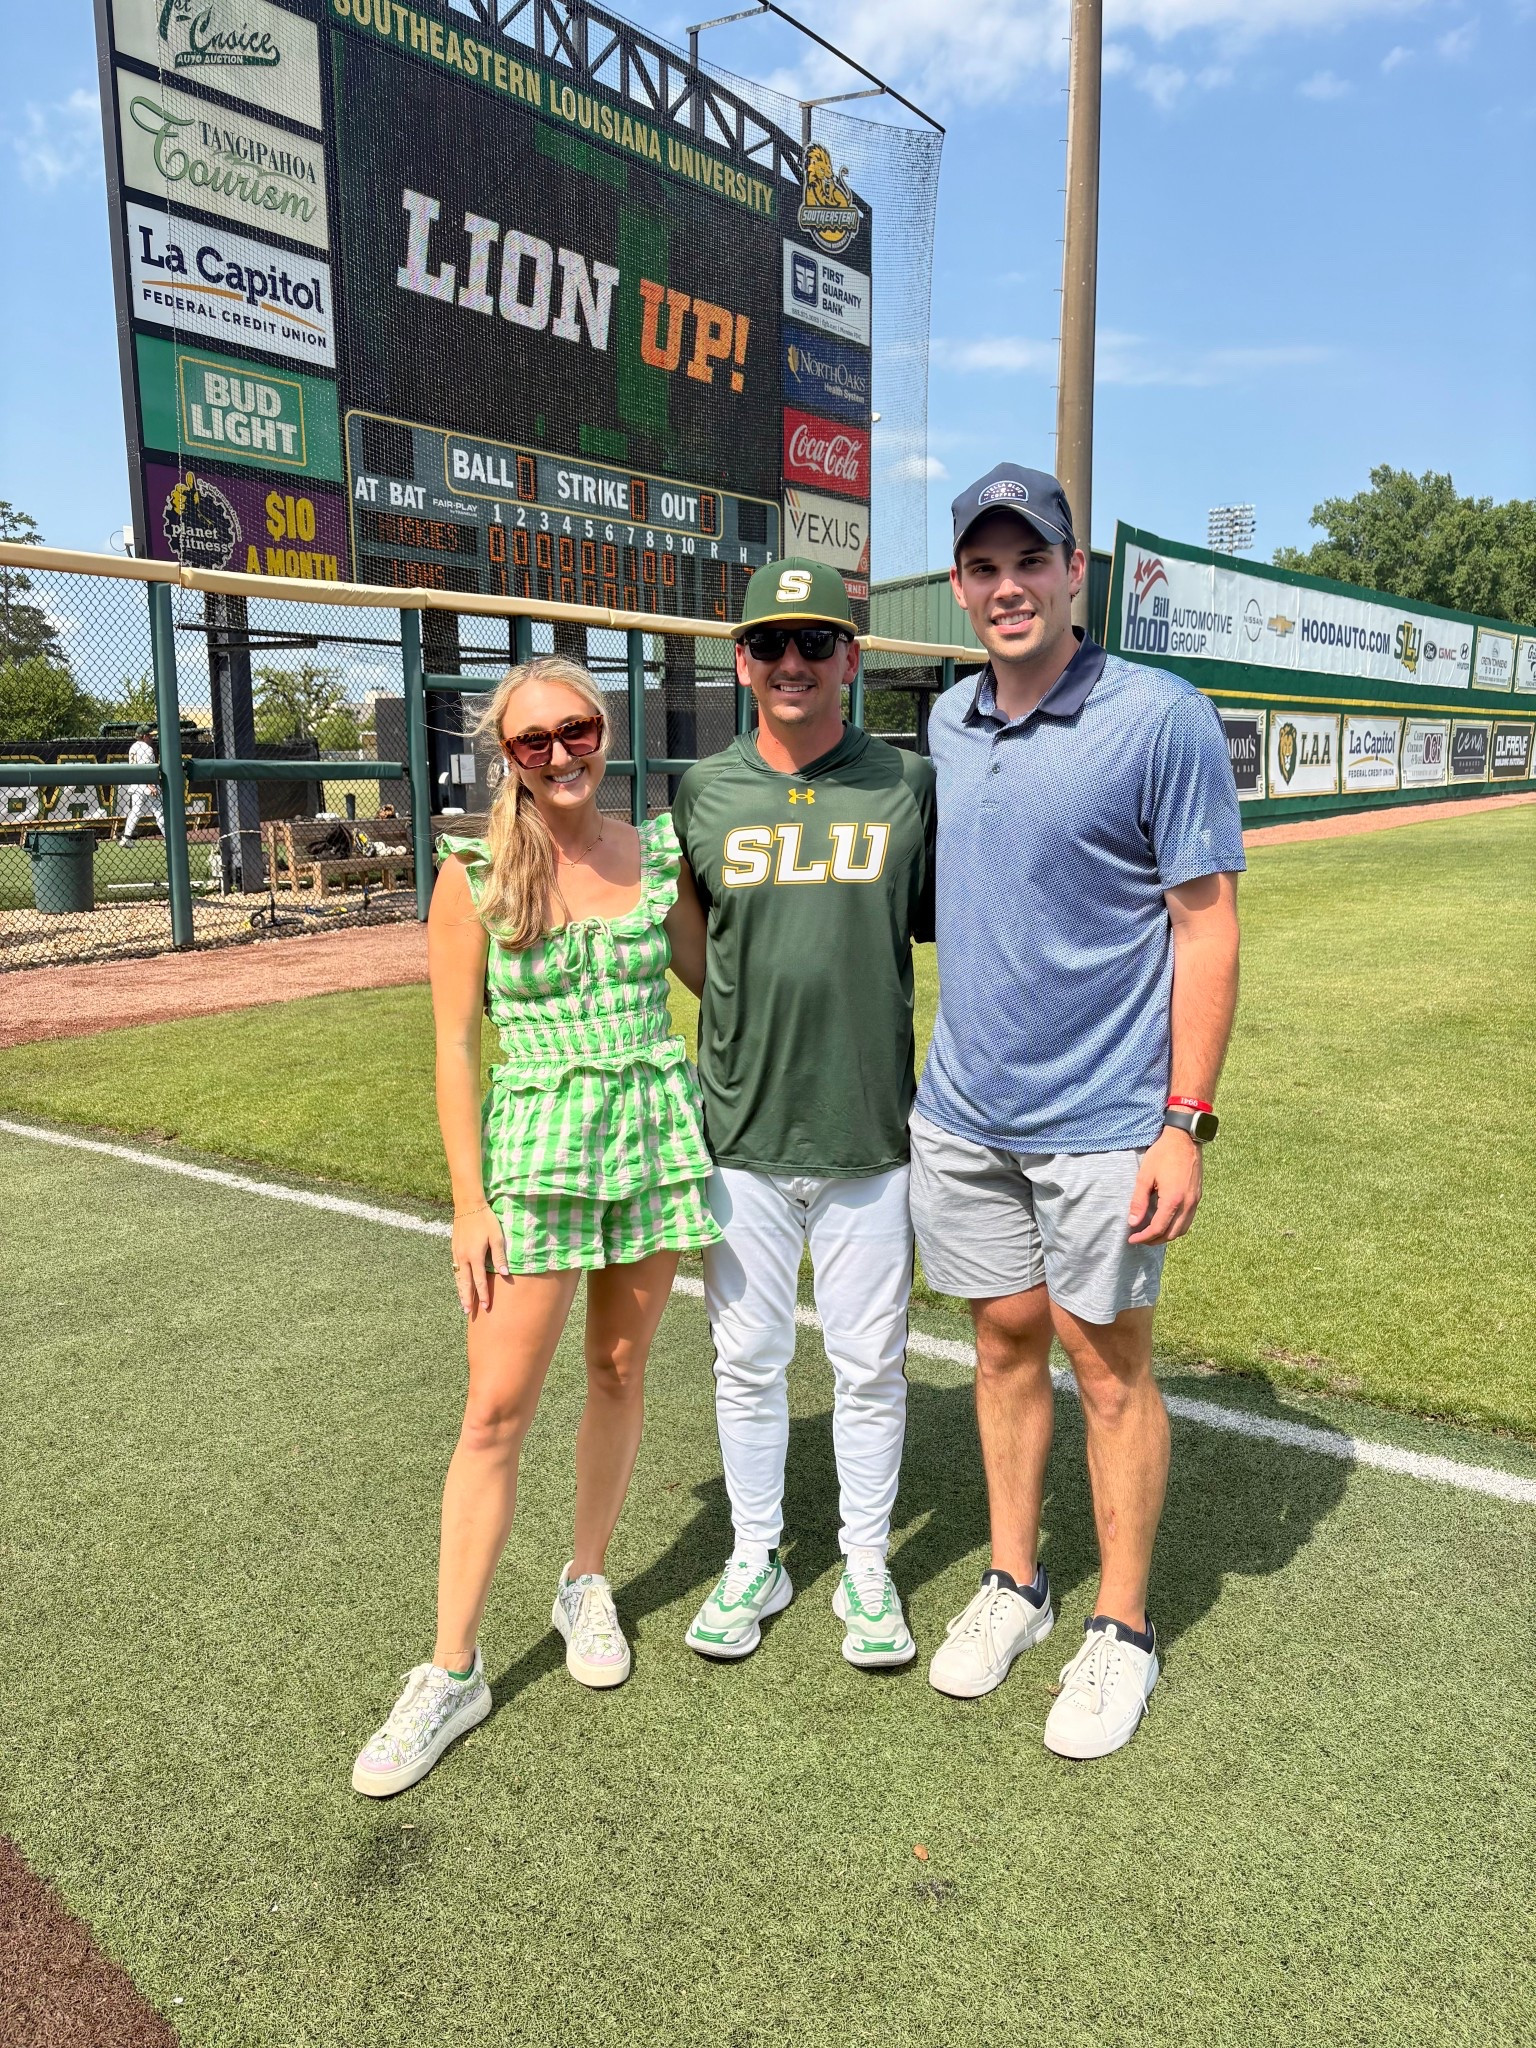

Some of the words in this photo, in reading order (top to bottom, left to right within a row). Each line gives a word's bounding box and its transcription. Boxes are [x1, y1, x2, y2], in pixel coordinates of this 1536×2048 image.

[177, 55, 202, 63] AUTO
[205, 55, 243, 64] AUCTION
[333, 0, 541, 106] SOUTHEASTERN
[550, 79, 662, 163] LOUISIANA
[668, 137, 773, 214] UNIVERSITY
[130, 96, 317, 222] Tourism
[198, 120, 316, 184] TANGIPAHOA
[138, 225, 188, 275] La
[196, 246, 324, 314] Capitol
[822, 265, 844, 286] FIRST
[396, 187, 620, 352] LION
[639, 277, 750, 394] UP!
[822, 281, 862, 309] GUARANTY
[822, 297, 844, 317] BANK
[143, 288, 217, 319] FEDERAL
[222, 310, 276, 334] CREDIT
[282, 325, 326, 348] UNION
[203, 371, 282, 418] BUD
[824, 381, 843, 396] Health
[844, 386, 865, 404] System
[190, 404, 297, 455] LIGHT
[789, 425, 862, 481] Coca-Cola
[355, 476, 378, 501] AT
[390, 481, 426, 510] BAT
[453, 449, 514, 488] BALL
[517, 455, 536, 500] 0
[557, 471, 629, 509] STRIKE
[631, 480, 646, 521] 0
[660, 492, 697, 522] OUT
[700, 494, 714, 533] 0
[172, 523, 218, 539] planet
[265, 490, 316, 542] $10
[493, 503, 502, 523] 1
[517, 507, 526, 527] 2
[540, 511, 549, 531] 3
[562, 516, 572, 534] 4
[585, 520, 594, 538] 5
[605, 523, 613, 541] 6
[627, 527, 635, 544] 7
[646, 530, 654, 548] 8
[666, 534, 673, 551] 9
[681, 537, 695, 555] 10
[711, 542, 718, 559] R
[740, 547, 747, 563] H
[787, 503, 860, 551] VEXUS
[180, 533, 229, 553] fitness
[489, 526, 505, 562] 0
[513, 530, 528, 565] 0
[536, 532, 551, 569] 0
[559, 537, 575, 572] 0
[581, 540, 596, 575] 0
[602, 544, 616, 577] 0
[643, 552, 657, 584] 0
[662, 554, 676, 586] 0
[246, 545, 262, 575] A
[267, 547, 338, 581] MONTH
[776, 570, 813, 603] S
[1124, 592, 1169, 653] HOOD
[1171, 607, 1232, 635] AUTOMOTIVE
[1153, 596, 1169, 619] Bill
[1244, 615, 1263, 626] NISSAN
[1170, 632, 1207, 653] GROUP
[1302, 618, 1390, 655] HOODAUTO.COM
[1394, 621, 1422, 663] SLU
[1438, 647, 1456, 661] GMC
[1227, 735, 1256, 760] MOM'S
[1299, 732, 1331, 767] LAA
[1349, 730, 1362, 754] La
[1364, 730, 1396, 760] Capitol
[1348, 769, 1367, 778] FEDERAL
[1368, 769, 1382, 778] CREDIT
[1382, 768, 1394, 777] UNION
[721, 822, 891, 888] SLU
